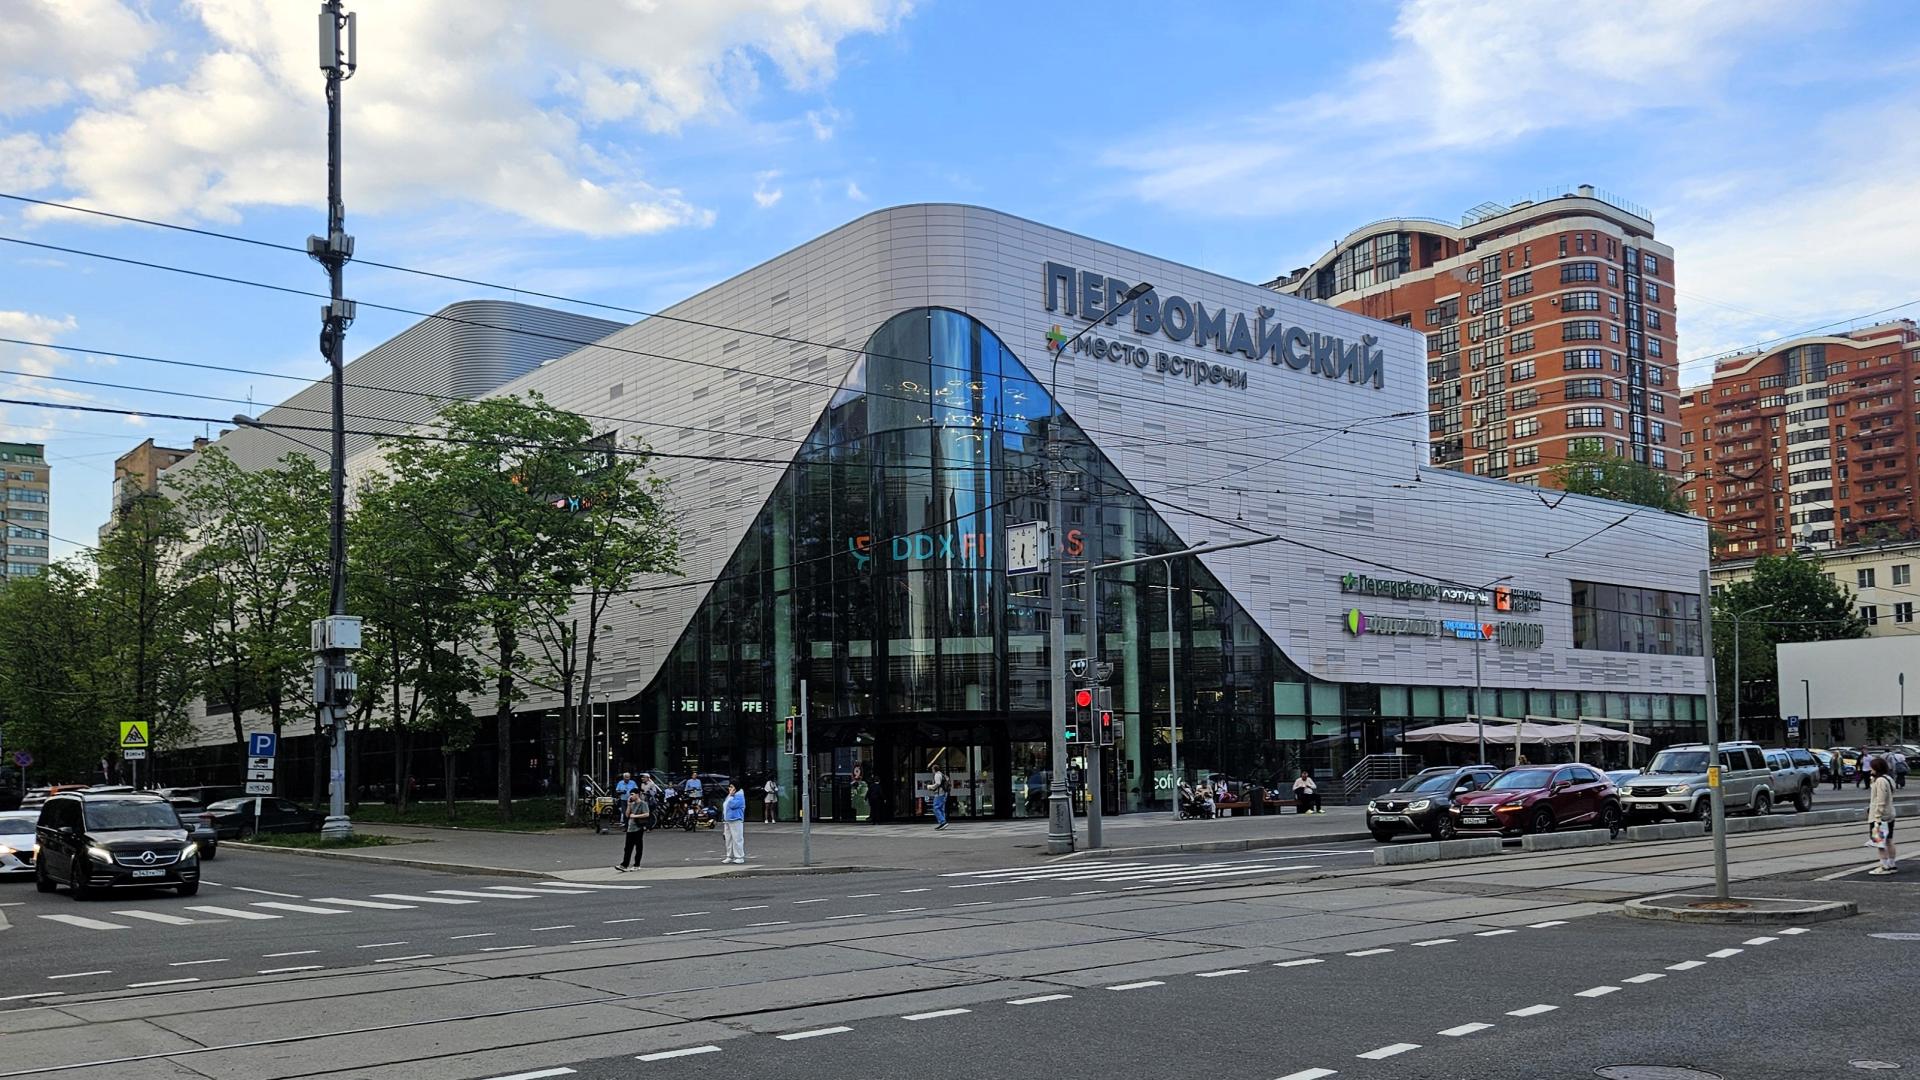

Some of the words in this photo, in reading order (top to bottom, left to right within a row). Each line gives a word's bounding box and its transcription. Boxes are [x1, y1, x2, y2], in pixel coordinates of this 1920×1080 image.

[1043, 261, 1384, 389] ПЕРВОМАЙСКИЙ
[1155, 351, 1247, 390] встречи
[1359, 574, 1439, 601] Перекрёсток
[256, 735, 271, 754] P
